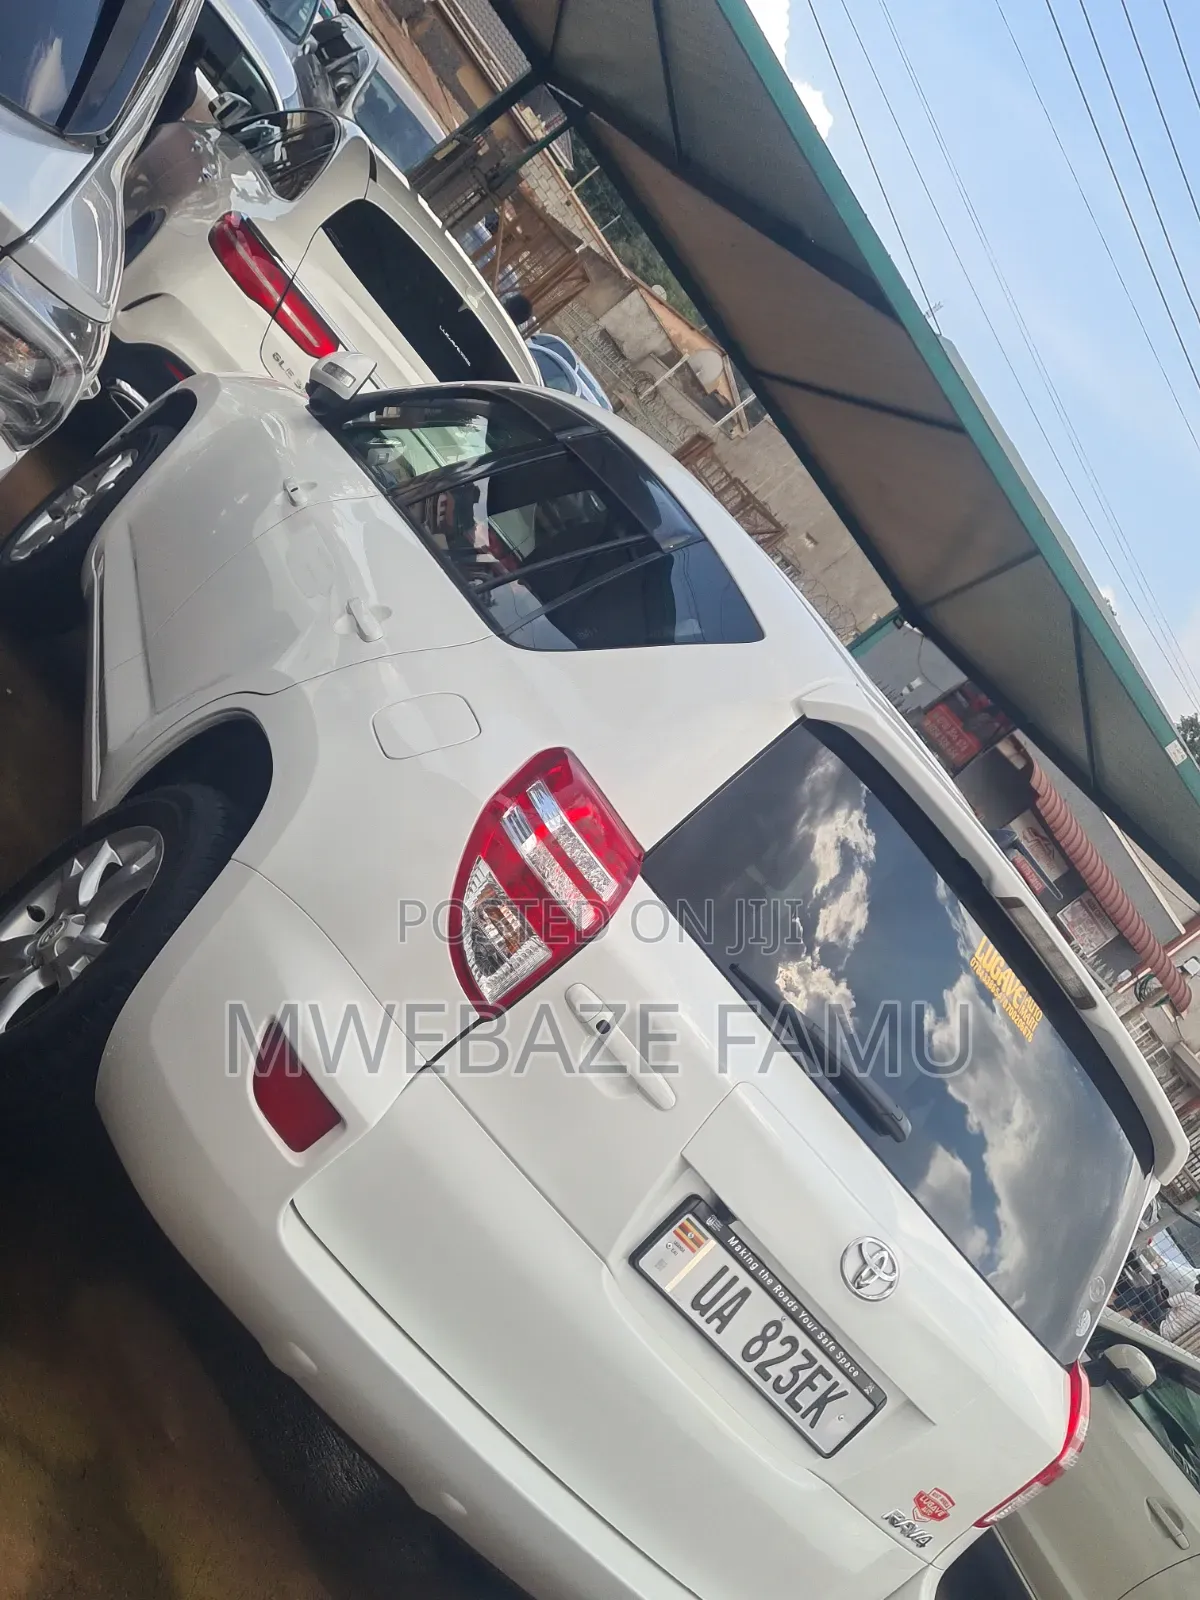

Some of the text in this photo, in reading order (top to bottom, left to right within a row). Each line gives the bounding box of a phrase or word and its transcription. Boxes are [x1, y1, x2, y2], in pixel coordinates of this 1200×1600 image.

[272, 352, 294, 379] GLE
[973, 935, 1026, 1008] LUGAVE
[1024, 995, 1044, 1022] AUTO
[727, 1236, 859, 1377] Making the Roads Your Safe Space
[691, 1266, 848, 1428] UA 823EK
[919, 1495, 944, 1516] LUGAVE
[881, 1508, 933, 1547] RAV4
